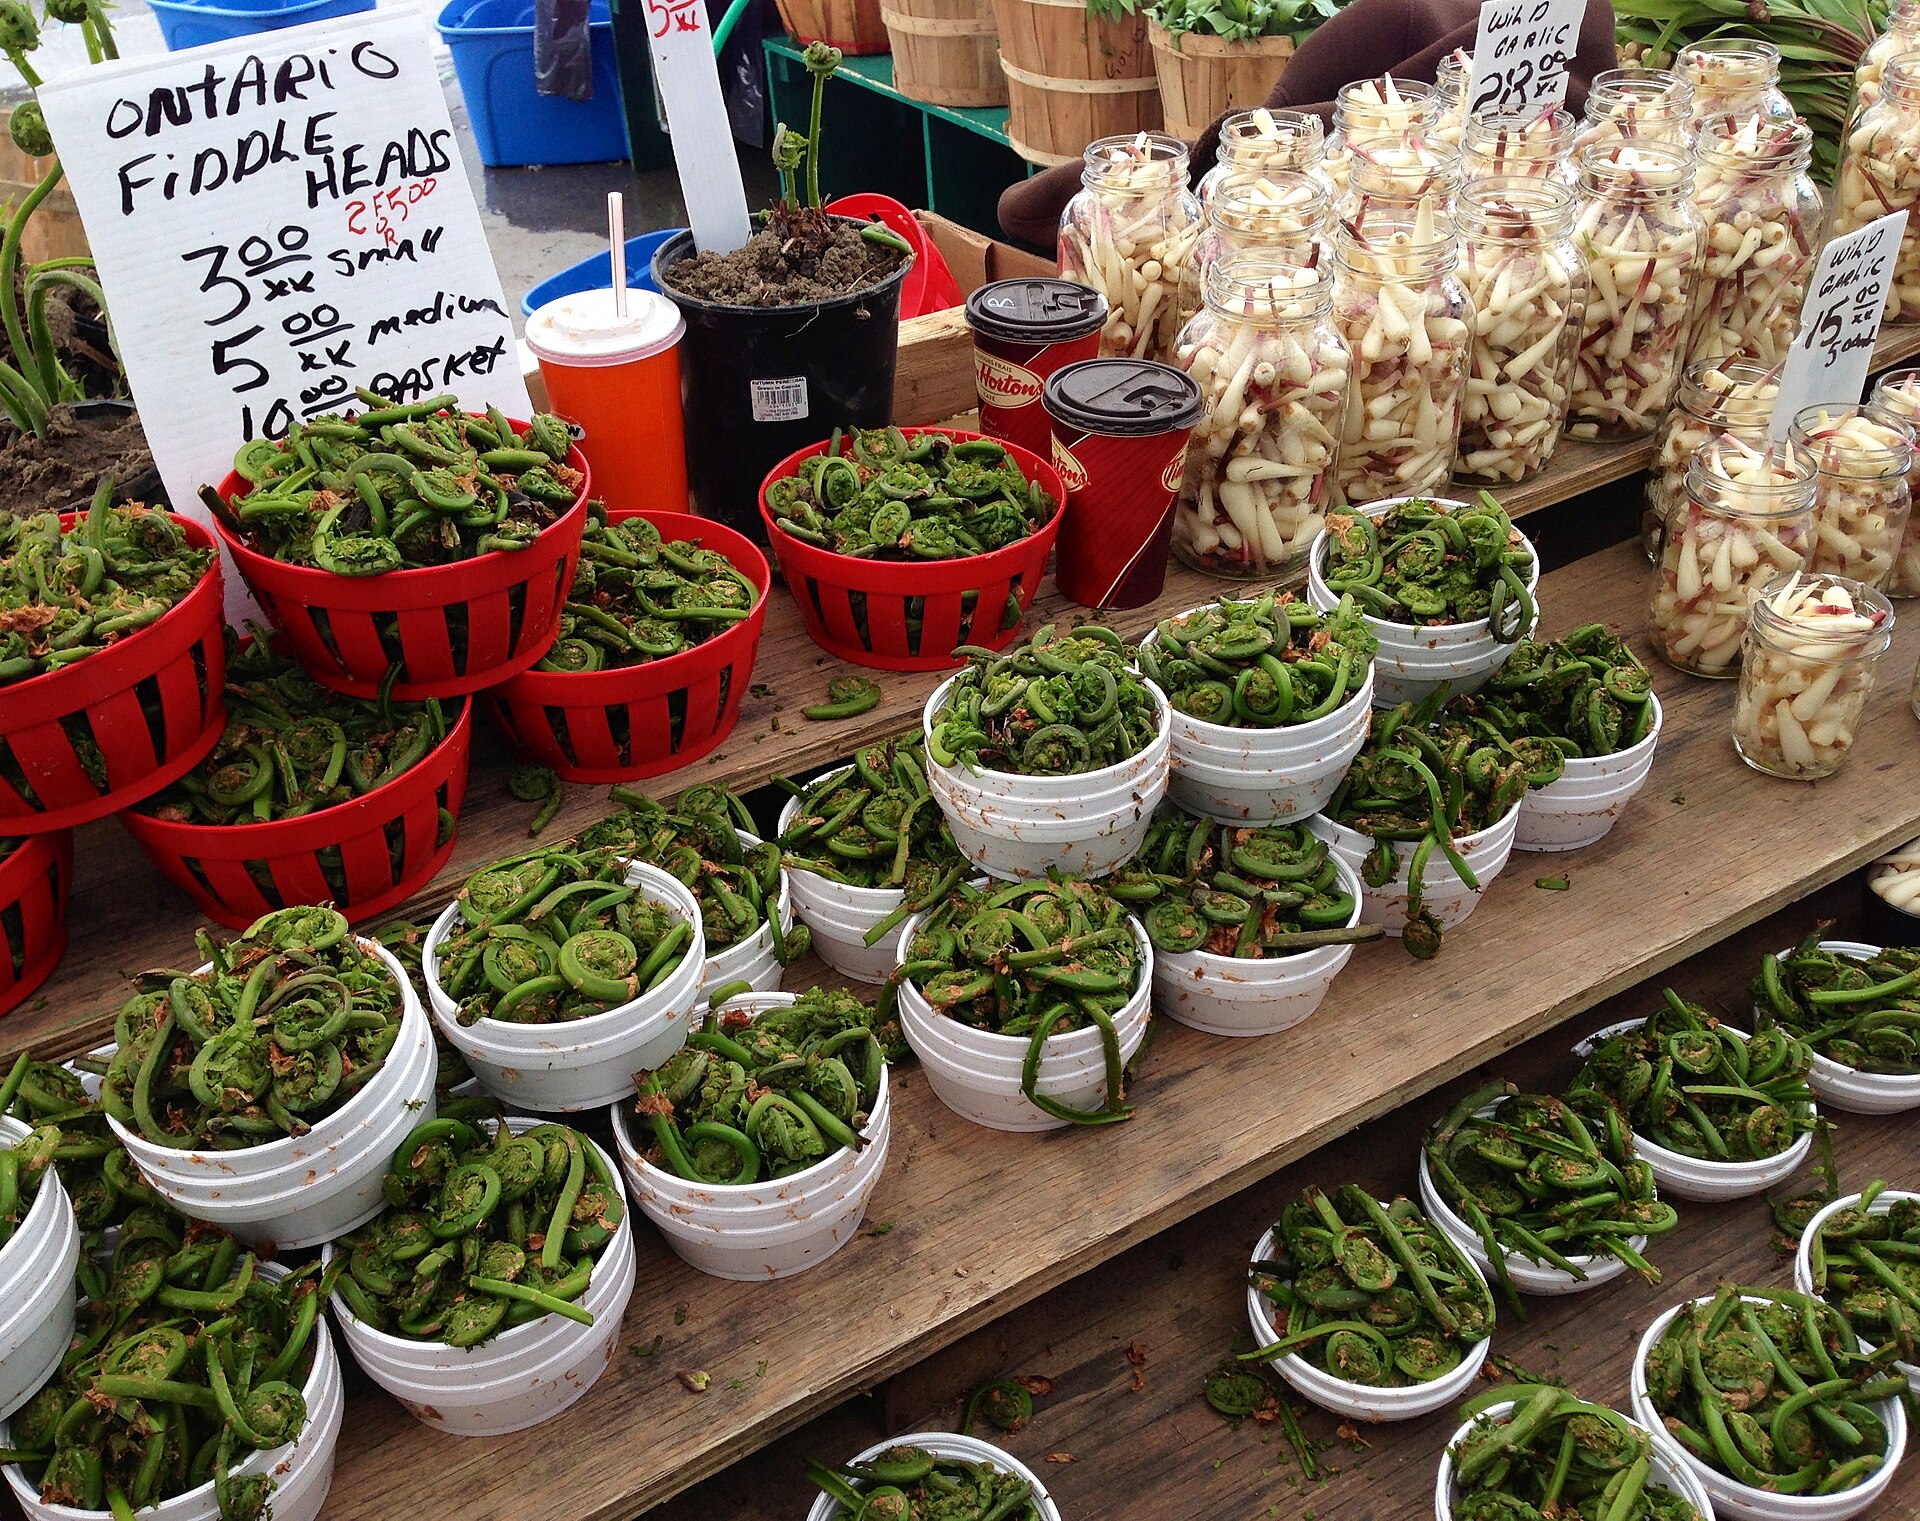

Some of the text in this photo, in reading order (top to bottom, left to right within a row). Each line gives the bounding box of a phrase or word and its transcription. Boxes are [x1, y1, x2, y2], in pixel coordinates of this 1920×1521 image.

[305, 128, 451, 209] HEADS
[367, 291, 508, 345] medium
[980, 362, 1043, 396] Hortons
